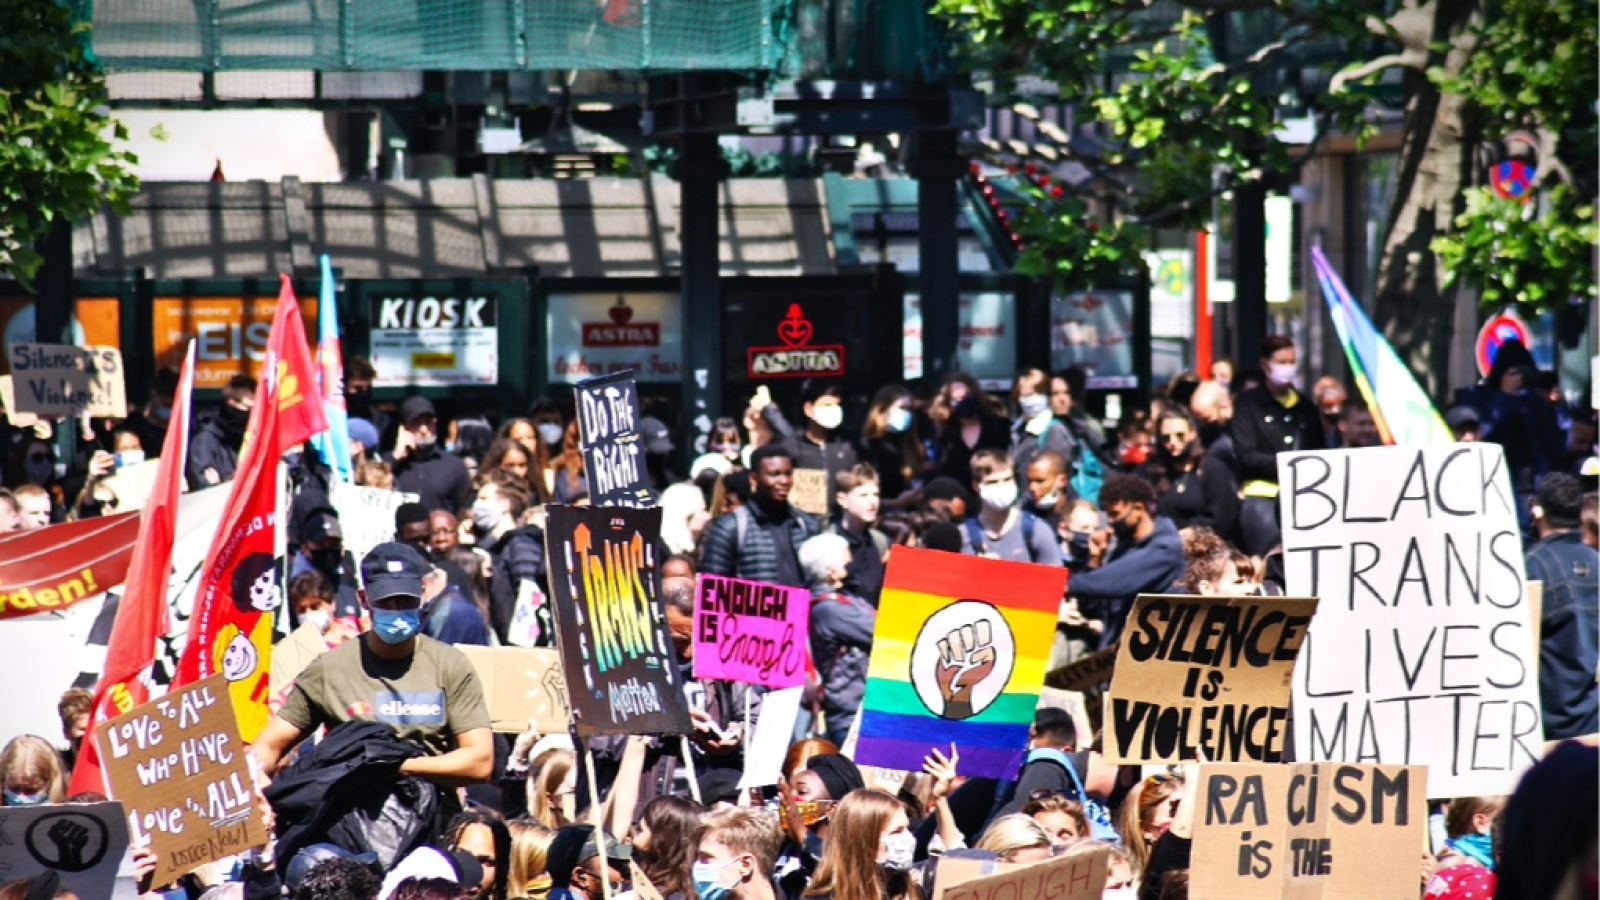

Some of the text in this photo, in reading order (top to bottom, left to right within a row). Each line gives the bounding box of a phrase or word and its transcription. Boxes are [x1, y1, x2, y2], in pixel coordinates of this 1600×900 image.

[380, 296, 487, 328] KIOSK
[588, 328, 654, 341] ASTRA
[196, 322, 271, 360] EIS
[1286, 447, 1512, 531] BLACK
[1287, 531, 1522, 611] TRANS
[701, 578, 789, 622] ENOUGH
[700, 613, 800, 681] IS Enough
[1129, 598, 1311, 668] SILENCE
[1306, 621, 1526, 698] LIVES
[179, 687, 215, 729] ALL
[1112, 697, 1289, 763] VIOLENCE
[1311, 692, 1540, 776] MATTER
[207, 771, 250, 819] ALL
[1290, 838, 1333, 877] THE
